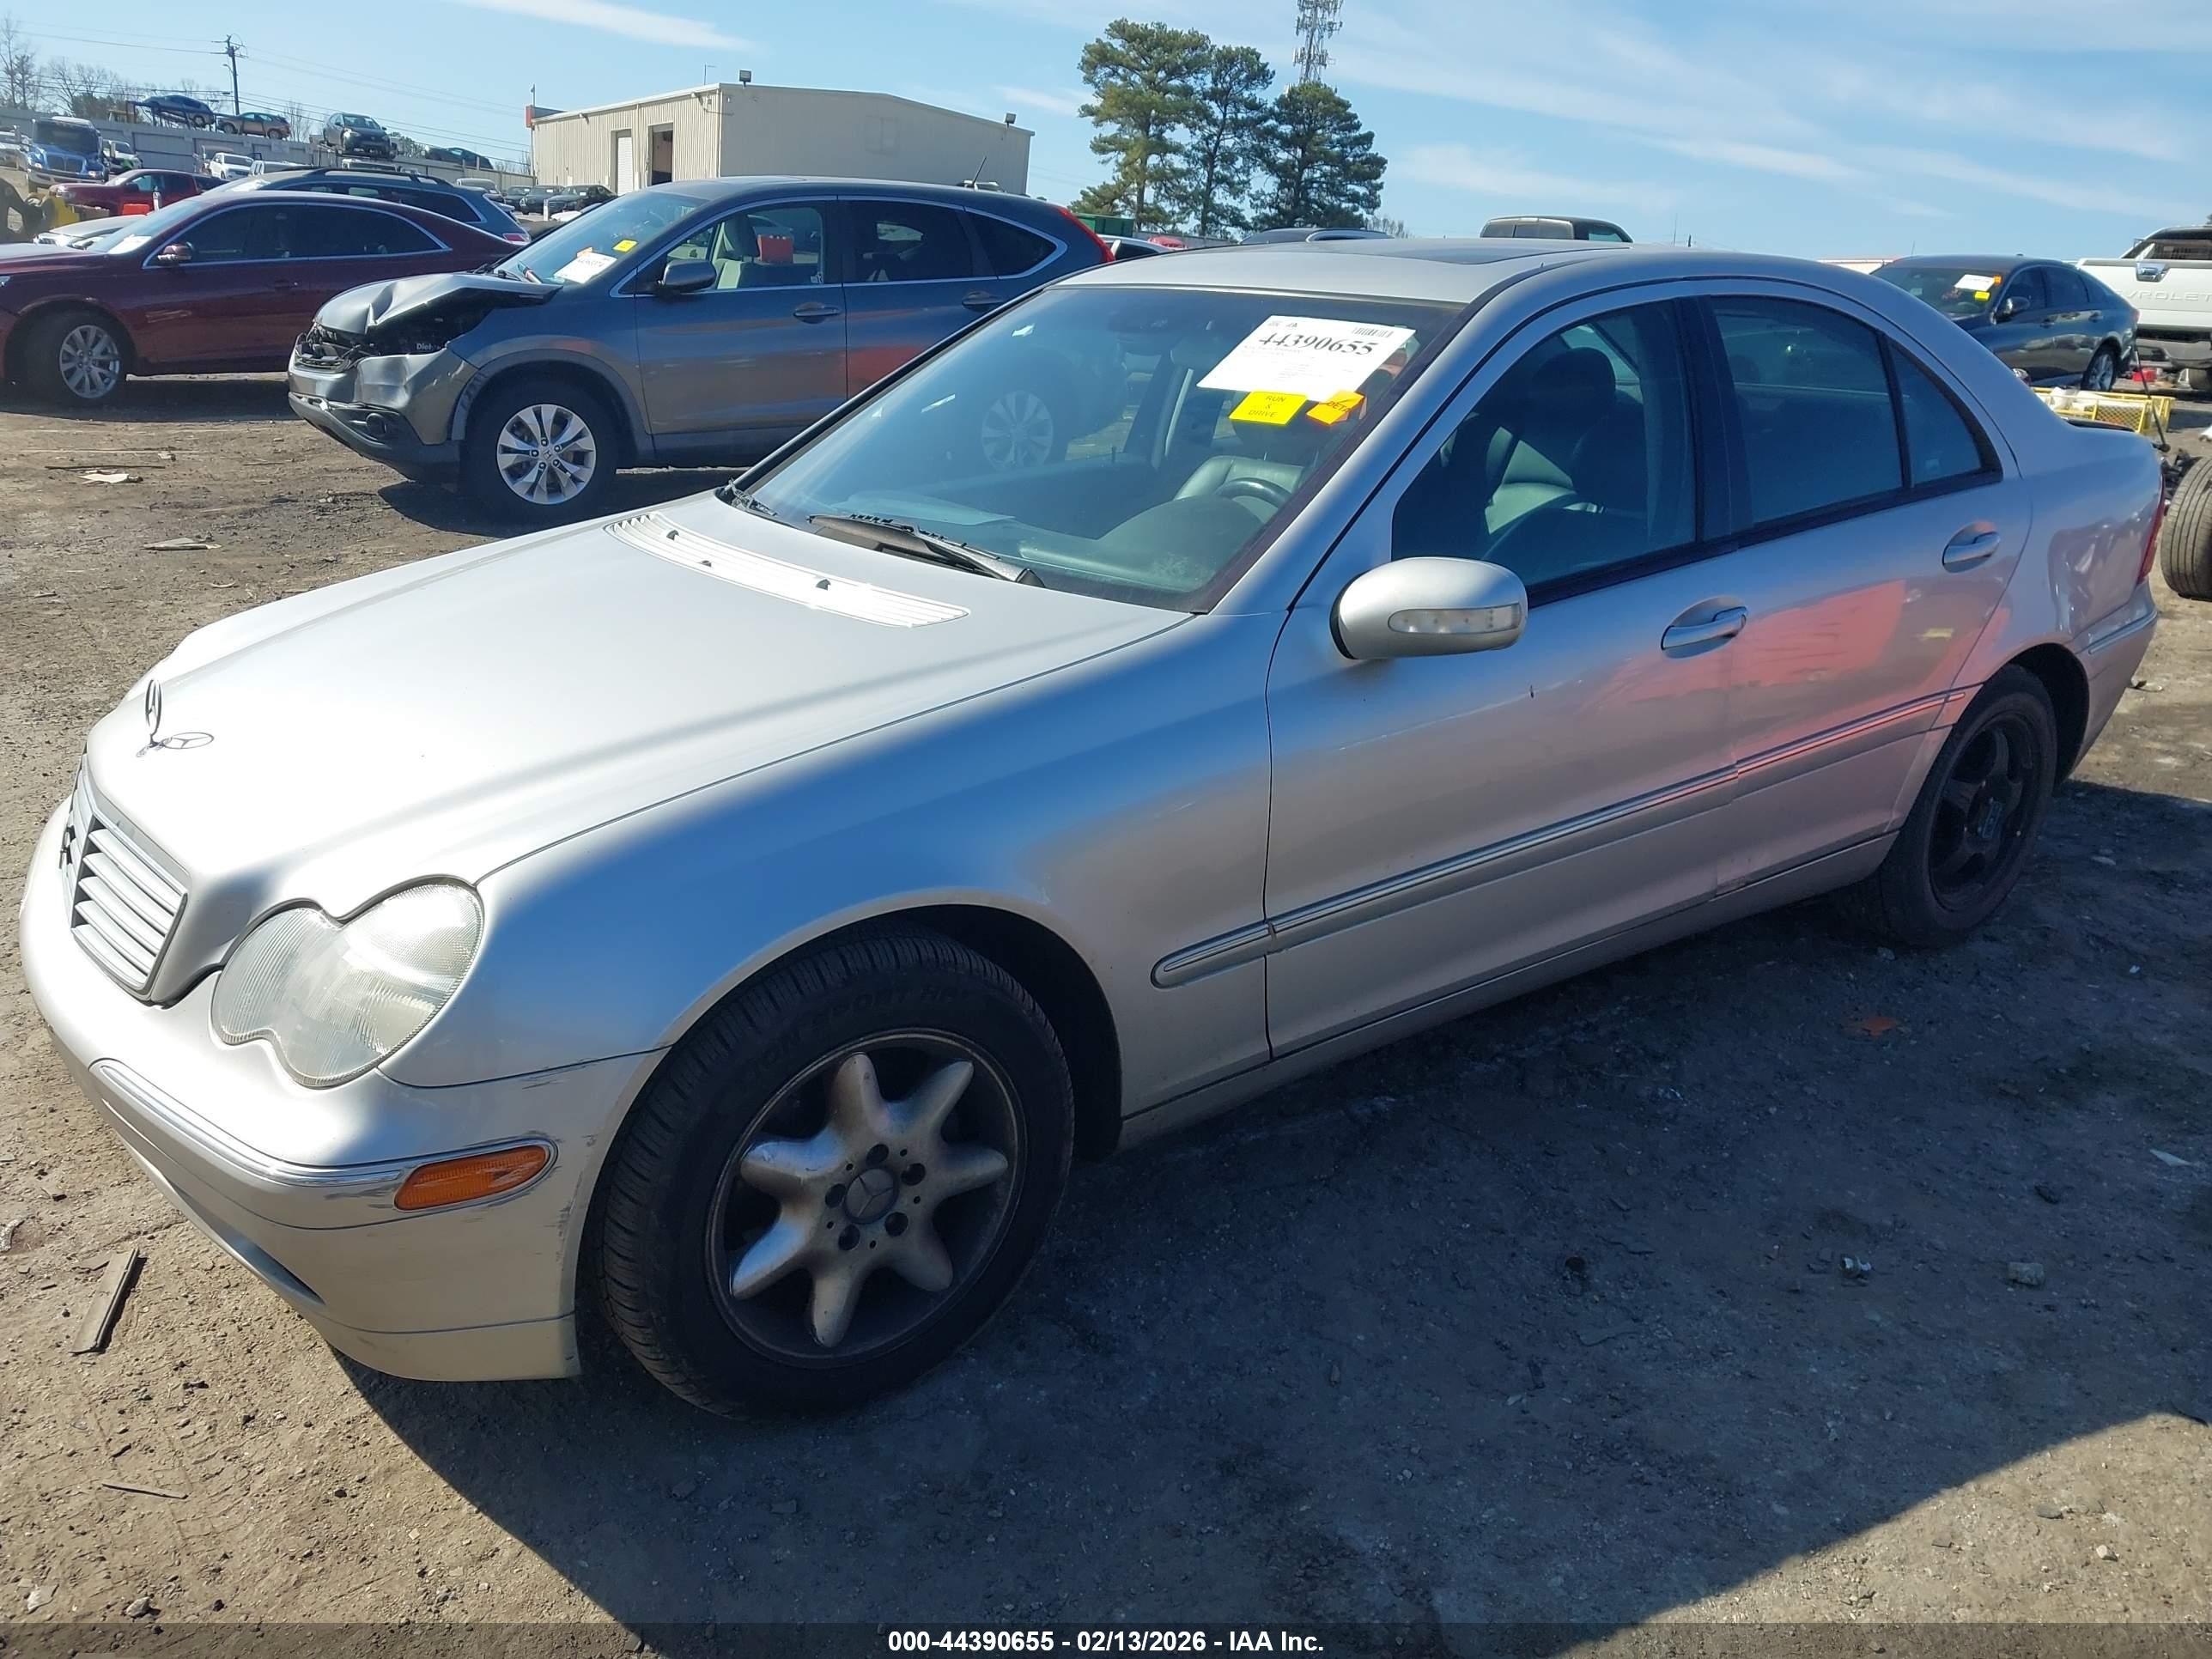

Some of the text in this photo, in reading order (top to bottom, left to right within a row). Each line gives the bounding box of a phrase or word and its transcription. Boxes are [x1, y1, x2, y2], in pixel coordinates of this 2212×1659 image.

[2120, 289, 2212, 302] VROLET
[1258, 333, 1379, 356] 44390655
[1249, 410, 1279, 418] DRIVE
